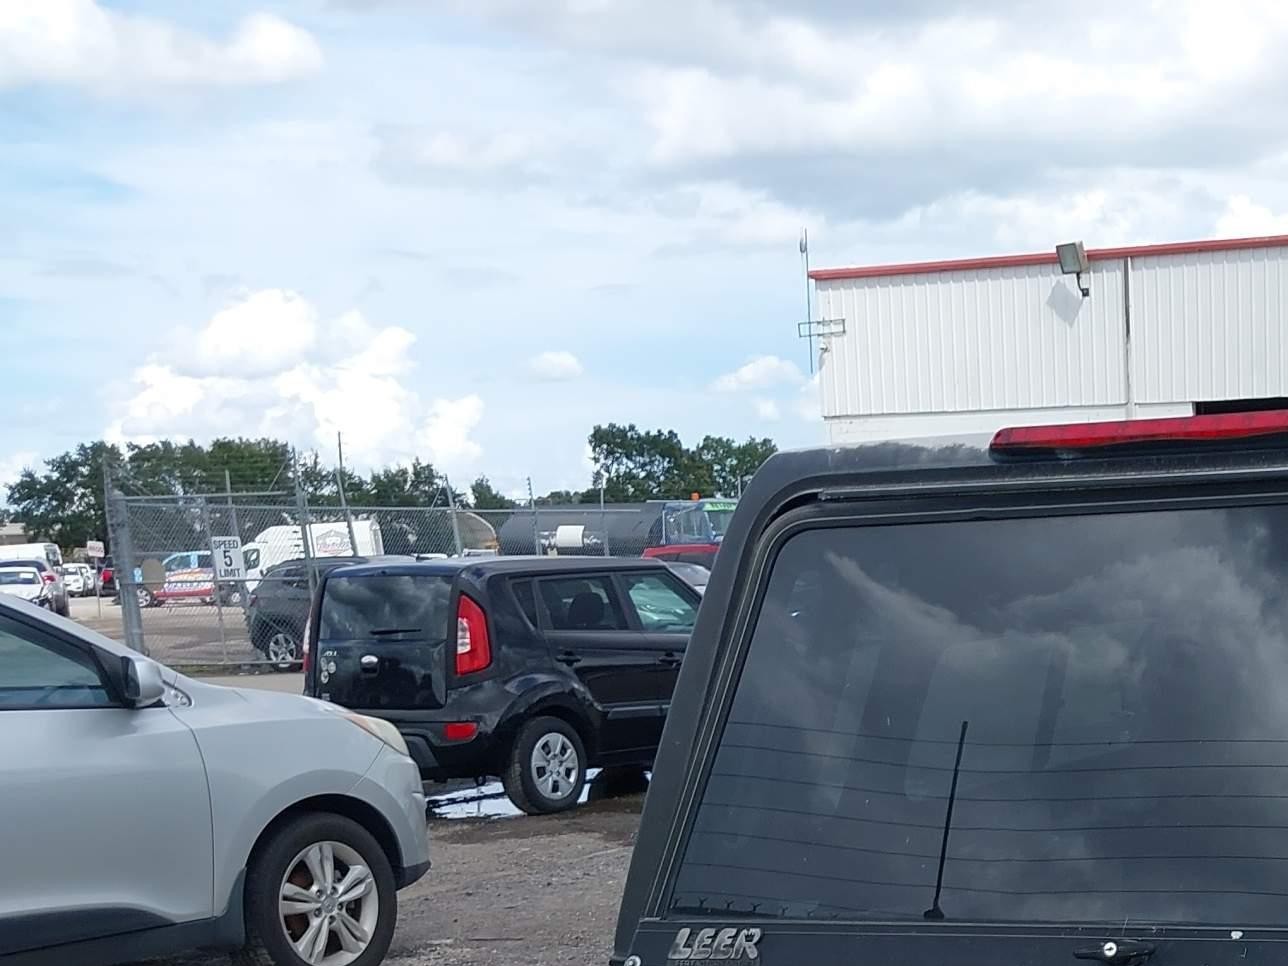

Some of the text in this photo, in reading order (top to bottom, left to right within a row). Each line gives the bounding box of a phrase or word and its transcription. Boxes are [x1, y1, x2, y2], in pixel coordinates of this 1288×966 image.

[213, 539, 239, 549] SPEED
[223, 550, 233, 567] 5
[219, 568, 241, 578] LIMIT
[667, 927, 762, 960] LEER
